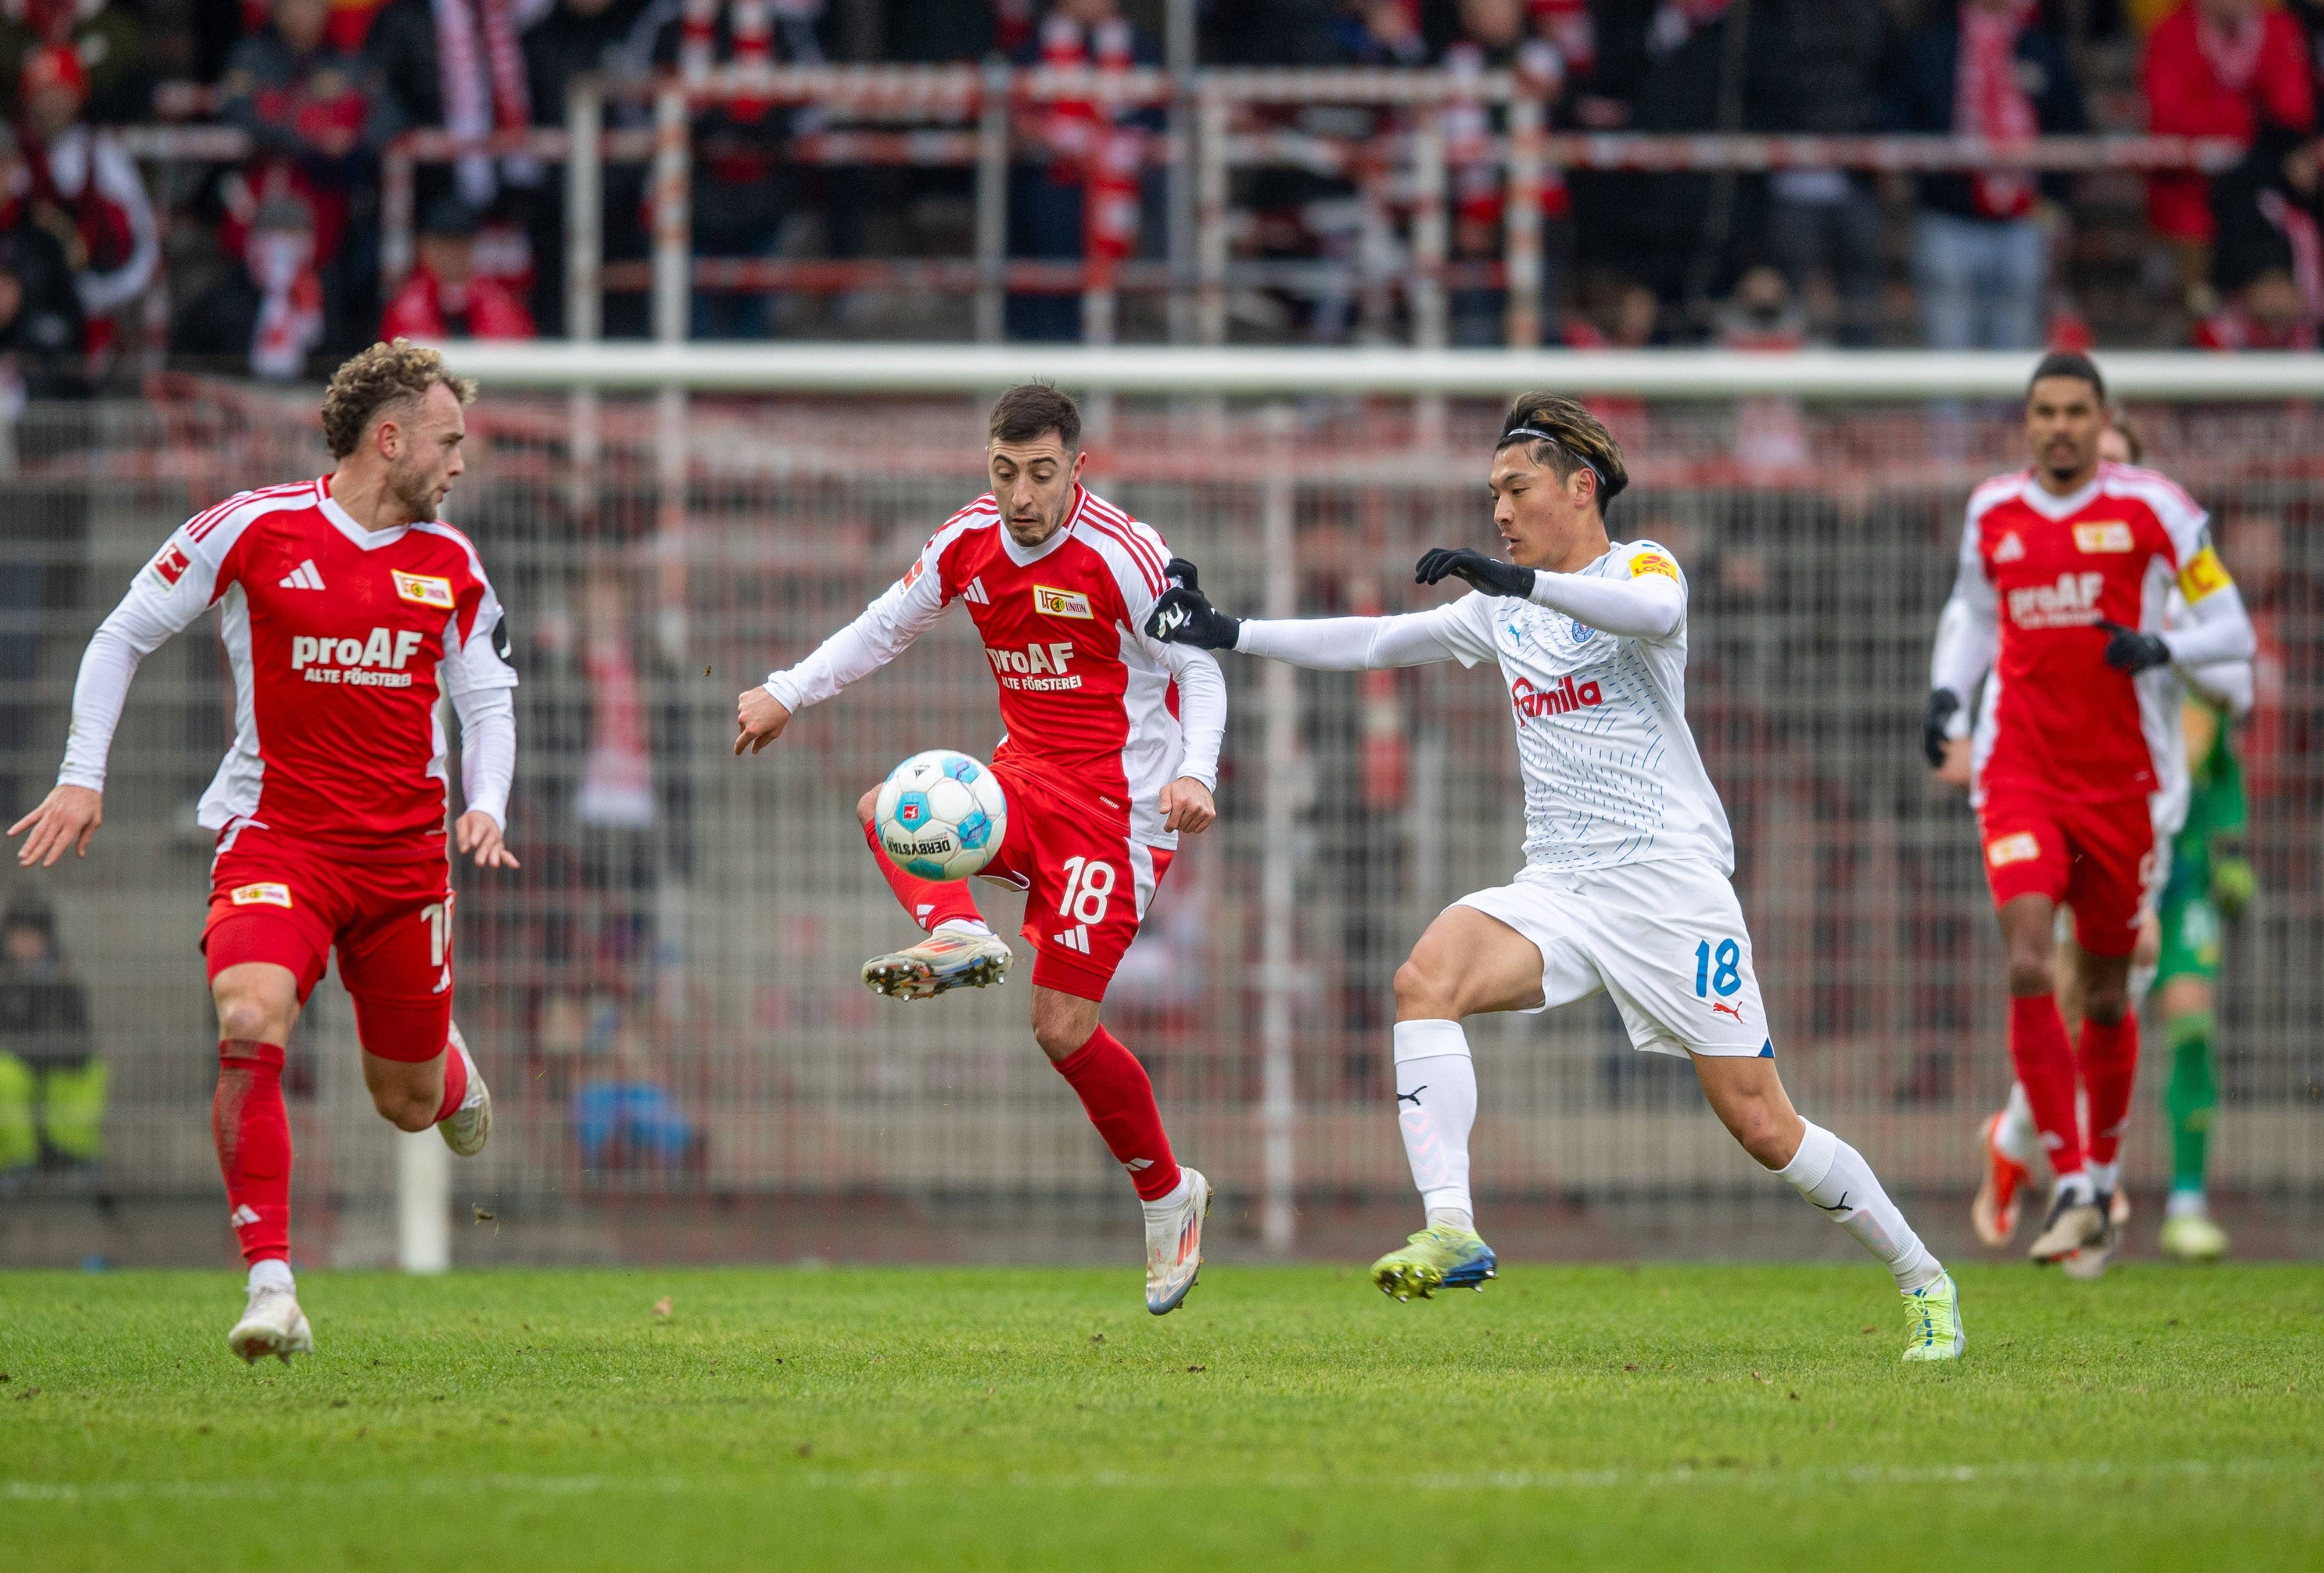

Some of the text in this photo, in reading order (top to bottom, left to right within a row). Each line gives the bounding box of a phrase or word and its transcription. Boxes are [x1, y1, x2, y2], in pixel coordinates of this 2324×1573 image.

[1065, 602, 1086, 613] UNION
[292, 627, 424, 670] proAF
[985, 642, 1074, 675] proAF
[304, 667, 342, 684] ALTE
[1021, 675, 1082, 691] FÖRSTEREI
[1512, 676, 1602, 727] famila
[1059, 856, 1116, 924] 18
[1695, 938, 1741, 998] 18
